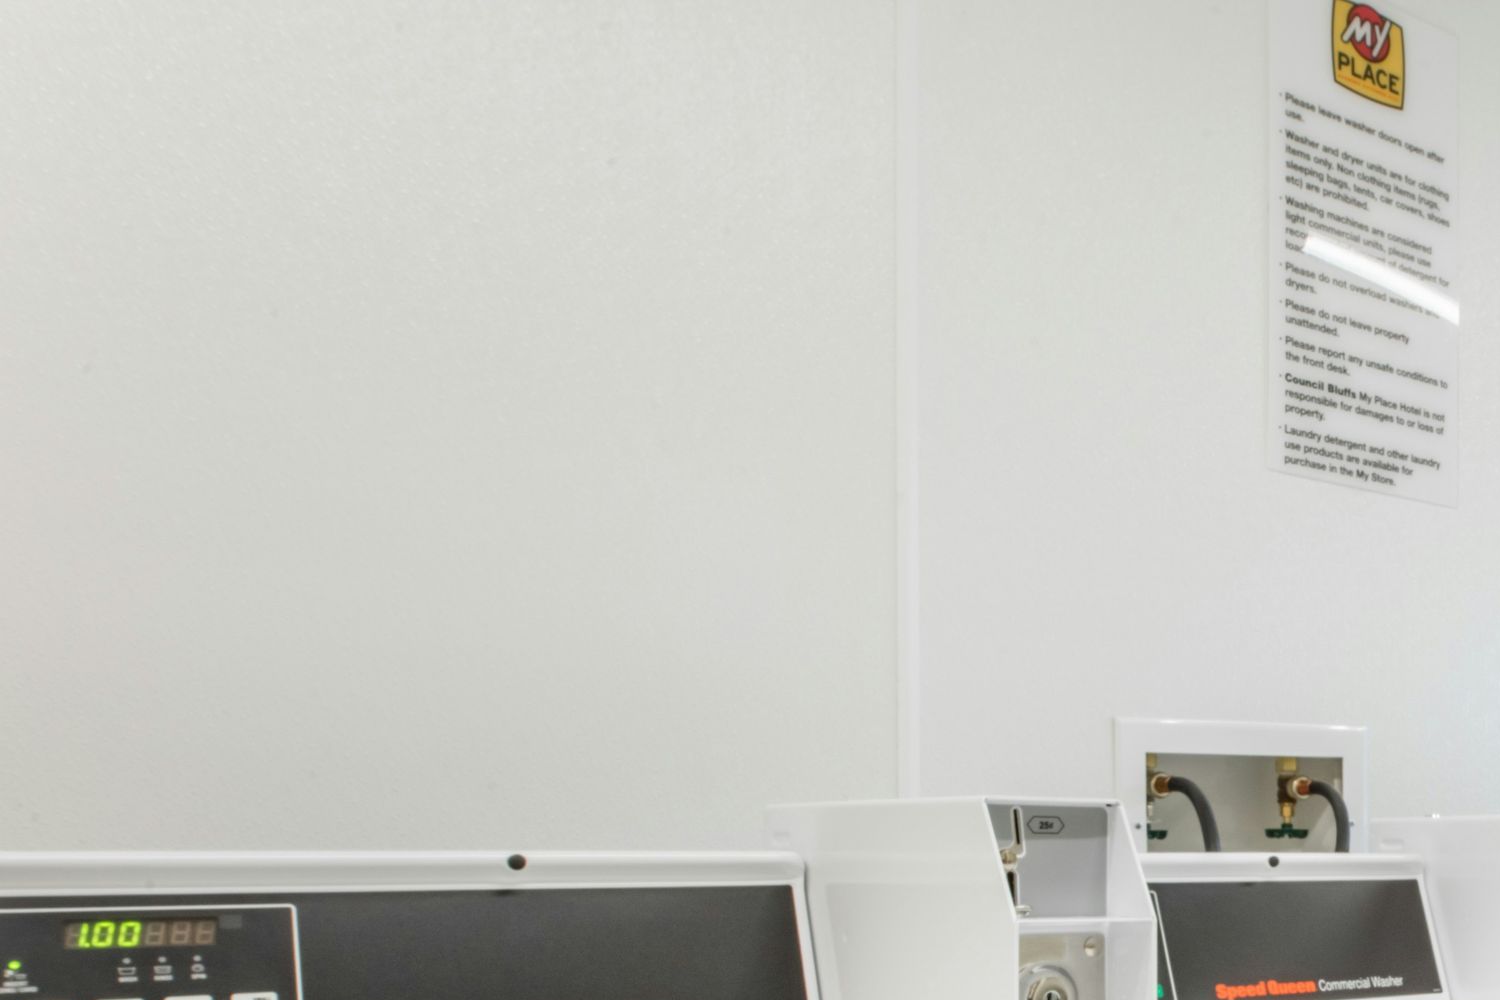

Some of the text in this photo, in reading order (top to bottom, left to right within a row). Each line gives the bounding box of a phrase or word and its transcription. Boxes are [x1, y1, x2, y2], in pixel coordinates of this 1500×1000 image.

[1338, 52, 1400, 95] PLACE
[1285, 91, 1316, 112] Please
[1318, 104, 1342, 122] leave
[1344, 118, 1376, 136] washer
[1378, 128, 1402, 146] doors
[1404, 141, 1424, 154] open
[1285, 129, 1449, 201] Washer and dryer units are for clothing
[1285, 160, 1324, 184] sleeping
[1336, 164, 1355, 179] Non
[1357, 173, 1391, 195] clothing
[1305, 183, 1320, 193] are
[1285, 195, 1324, 218] Washing
[1326, 212, 1369, 231] machines
[1371, 226, 1385, 236] are
[1285, 210, 1306, 226] light
[1308, 221, 1360, 244] commercial
[1388, 245, 1415, 262] please
[1417, 256, 1431, 267] use
[1285, 261, 1316, 279] Please
[1318, 271, 1330, 283] do
[1332, 279, 1347, 289] not
[1349, 284, 1387, 302] overload
[1389, 297, 1423, 313] washers
[1285, 298, 1409, 344] Please do not leave property
[1285, 351, 1300, 363] the
[1302, 355, 1324, 370] front
[1285, 335, 1448, 388] Please report any unsafe conditions to
[1285, 372, 1444, 421] Council Bluffs My Place Hotel is not
[1285, 390, 1444, 434] responsible for damages to or loss of
[1284, 423, 1440, 470] Laundry detergent and other laundry
[1284, 442, 1413, 475] use products are available for
[1284, 457, 1395, 485] purchase in the My Store.
[1268, 978, 1316, 995] Queen
[1318, 976, 1370, 992] Commercial
[1372, 975, 1404, 989] Washer
